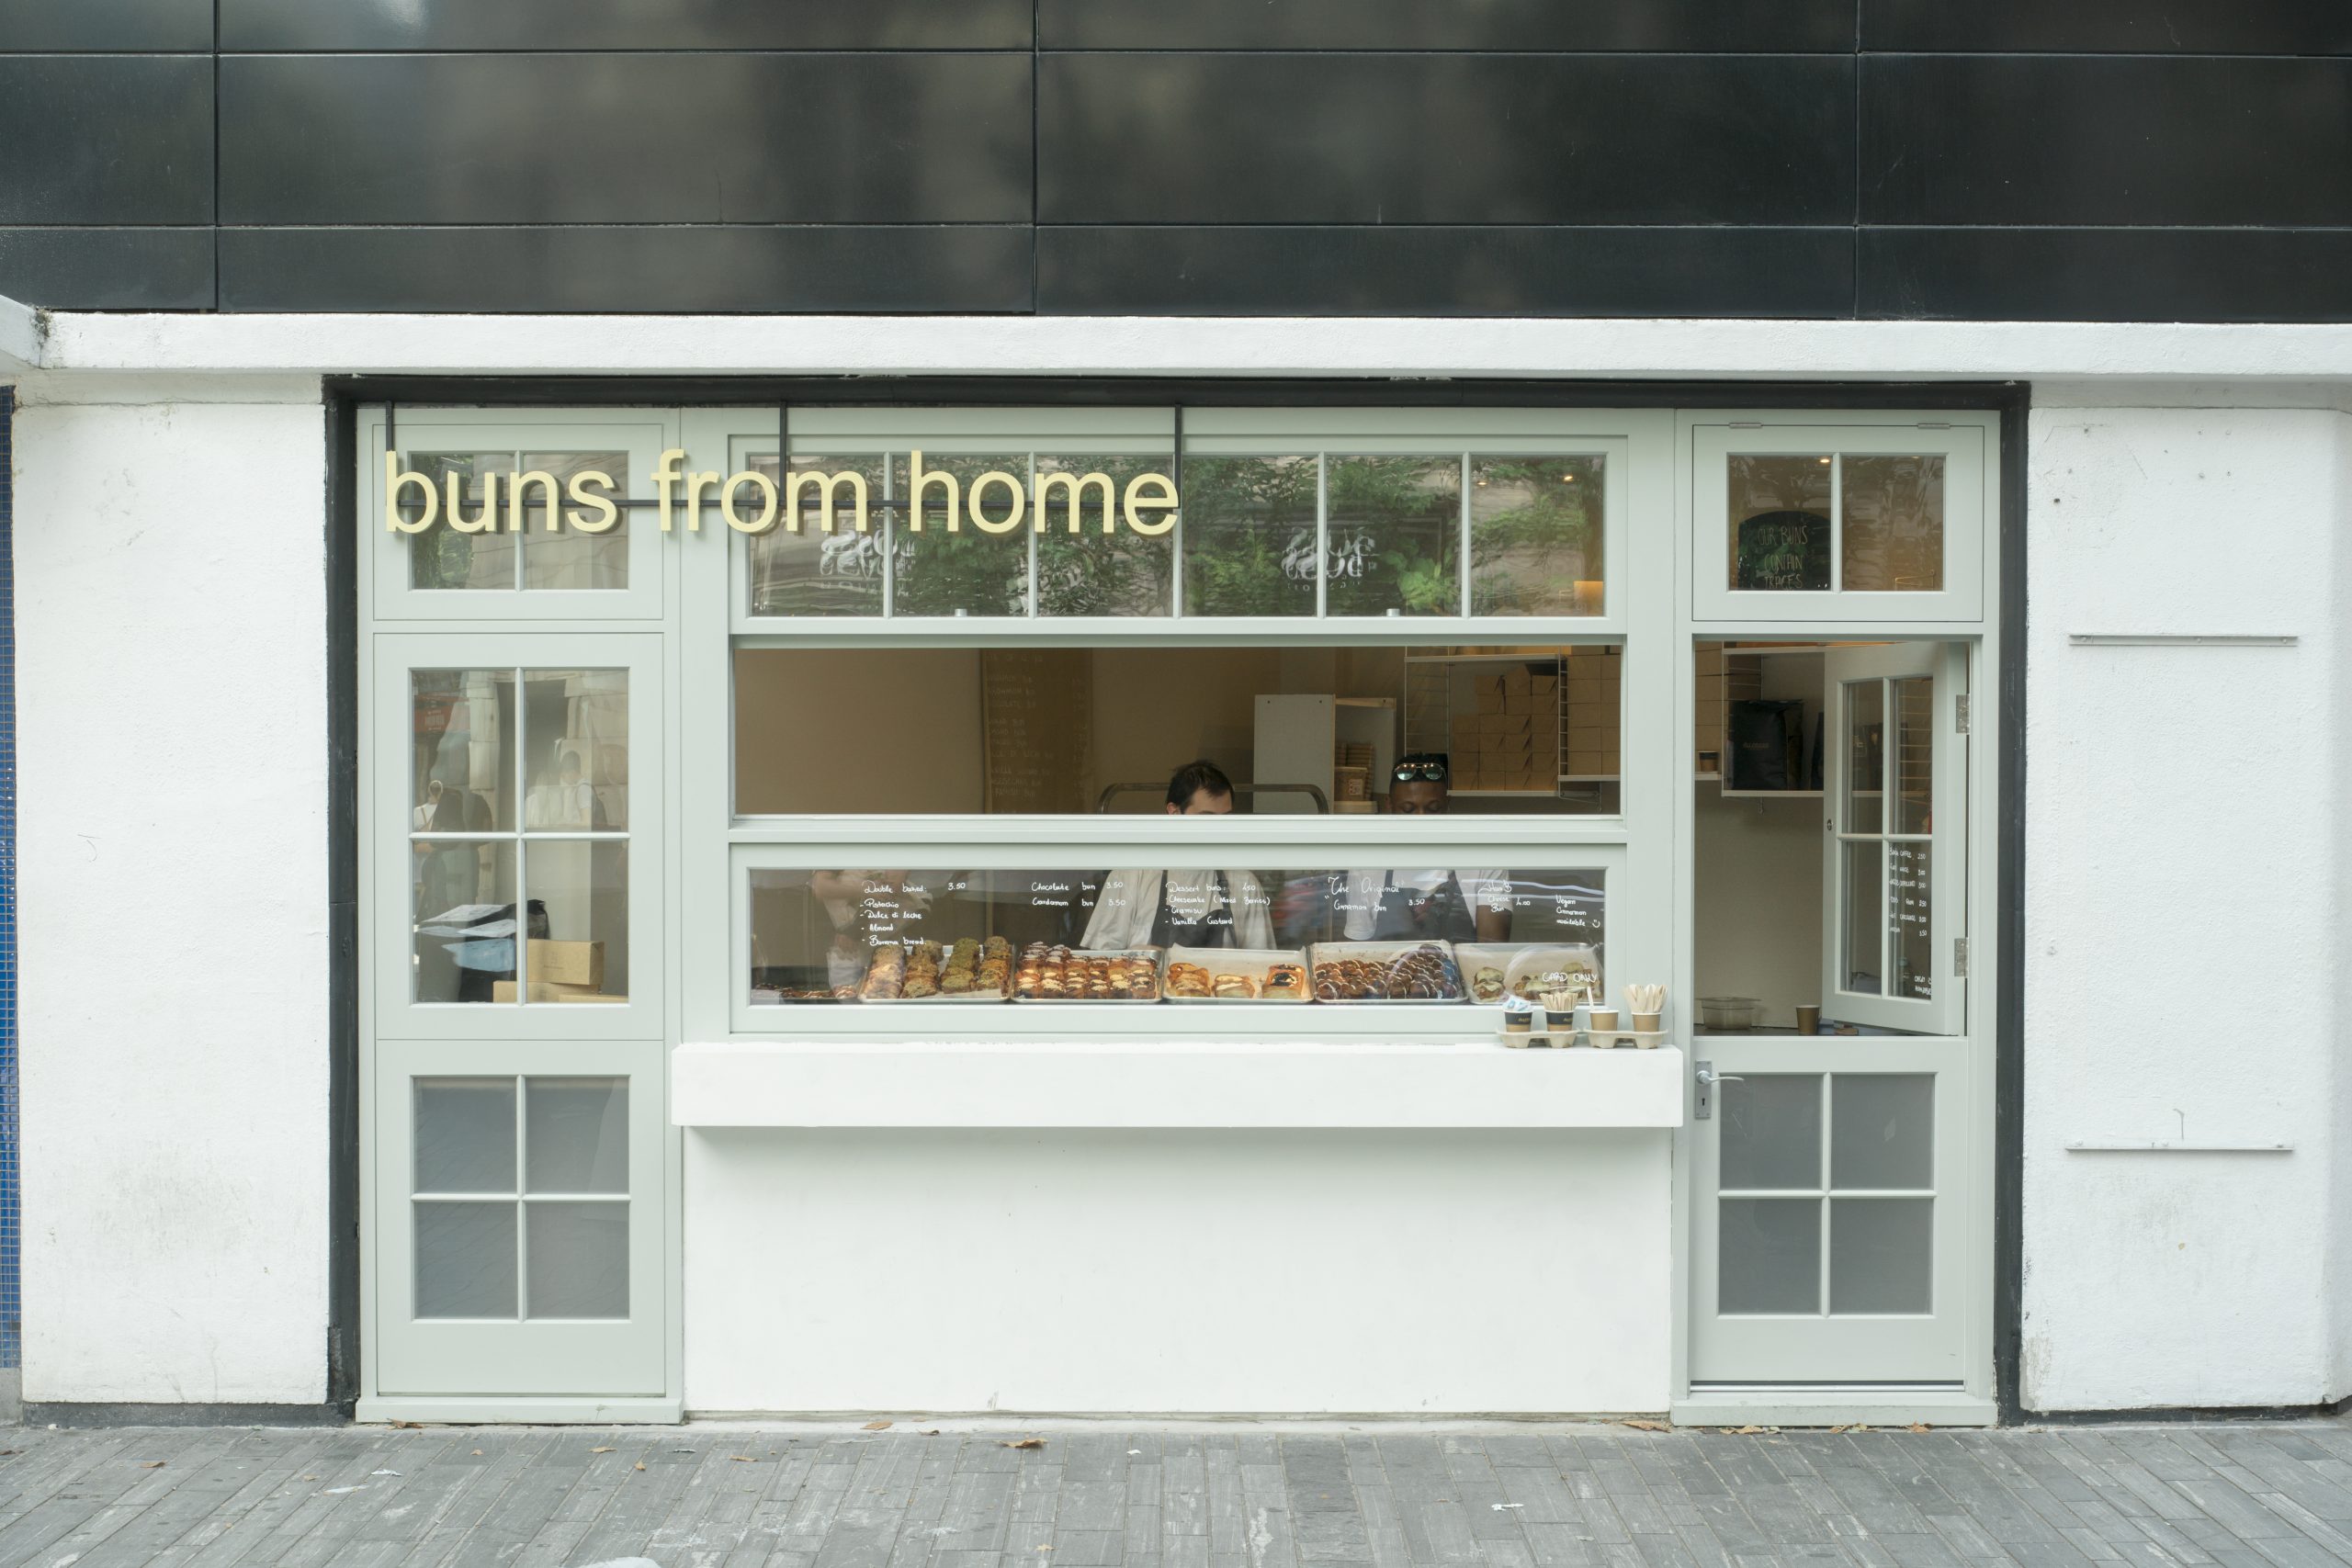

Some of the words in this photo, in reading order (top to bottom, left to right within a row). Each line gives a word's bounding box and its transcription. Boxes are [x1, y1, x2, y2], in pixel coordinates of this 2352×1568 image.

[387, 451, 616, 532] buns
[651, 449, 866, 532] from
[910, 450, 1178, 534] home
[1758, 527, 1777, 546] OUR
[1781, 525, 1808, 546] BUNS
[1764, 552, 1804, 573] CONTAIN
[1764, 573, 1803, 590] TRACES
[862, 880, 893, 894] Double
[947, 882, 967, 891] 3.50
[1031, 882, 1069, 892] Chocolate
[1081, 882, 1096, 891] bun
[1166, 881, 1199, 893] Dessert
[1081, 898, 1094, 907] bun
[1408, 898, 1426, 907] 3.50
[1555, 895, 1577, 908] Vegan
[864, 909, 889, 919] Dulce
[902, 910, 923, 919] leche
[1172, 917, 1197, 926] Vanilla
[1206, 916, 1233, 925] Custard
[869, 923, 894, 932] Almond
[868, 934, 899, 947] Banana
[1543, 971, 1568, 982] CARD
[1573, 973, 1597, 983] ONLY
